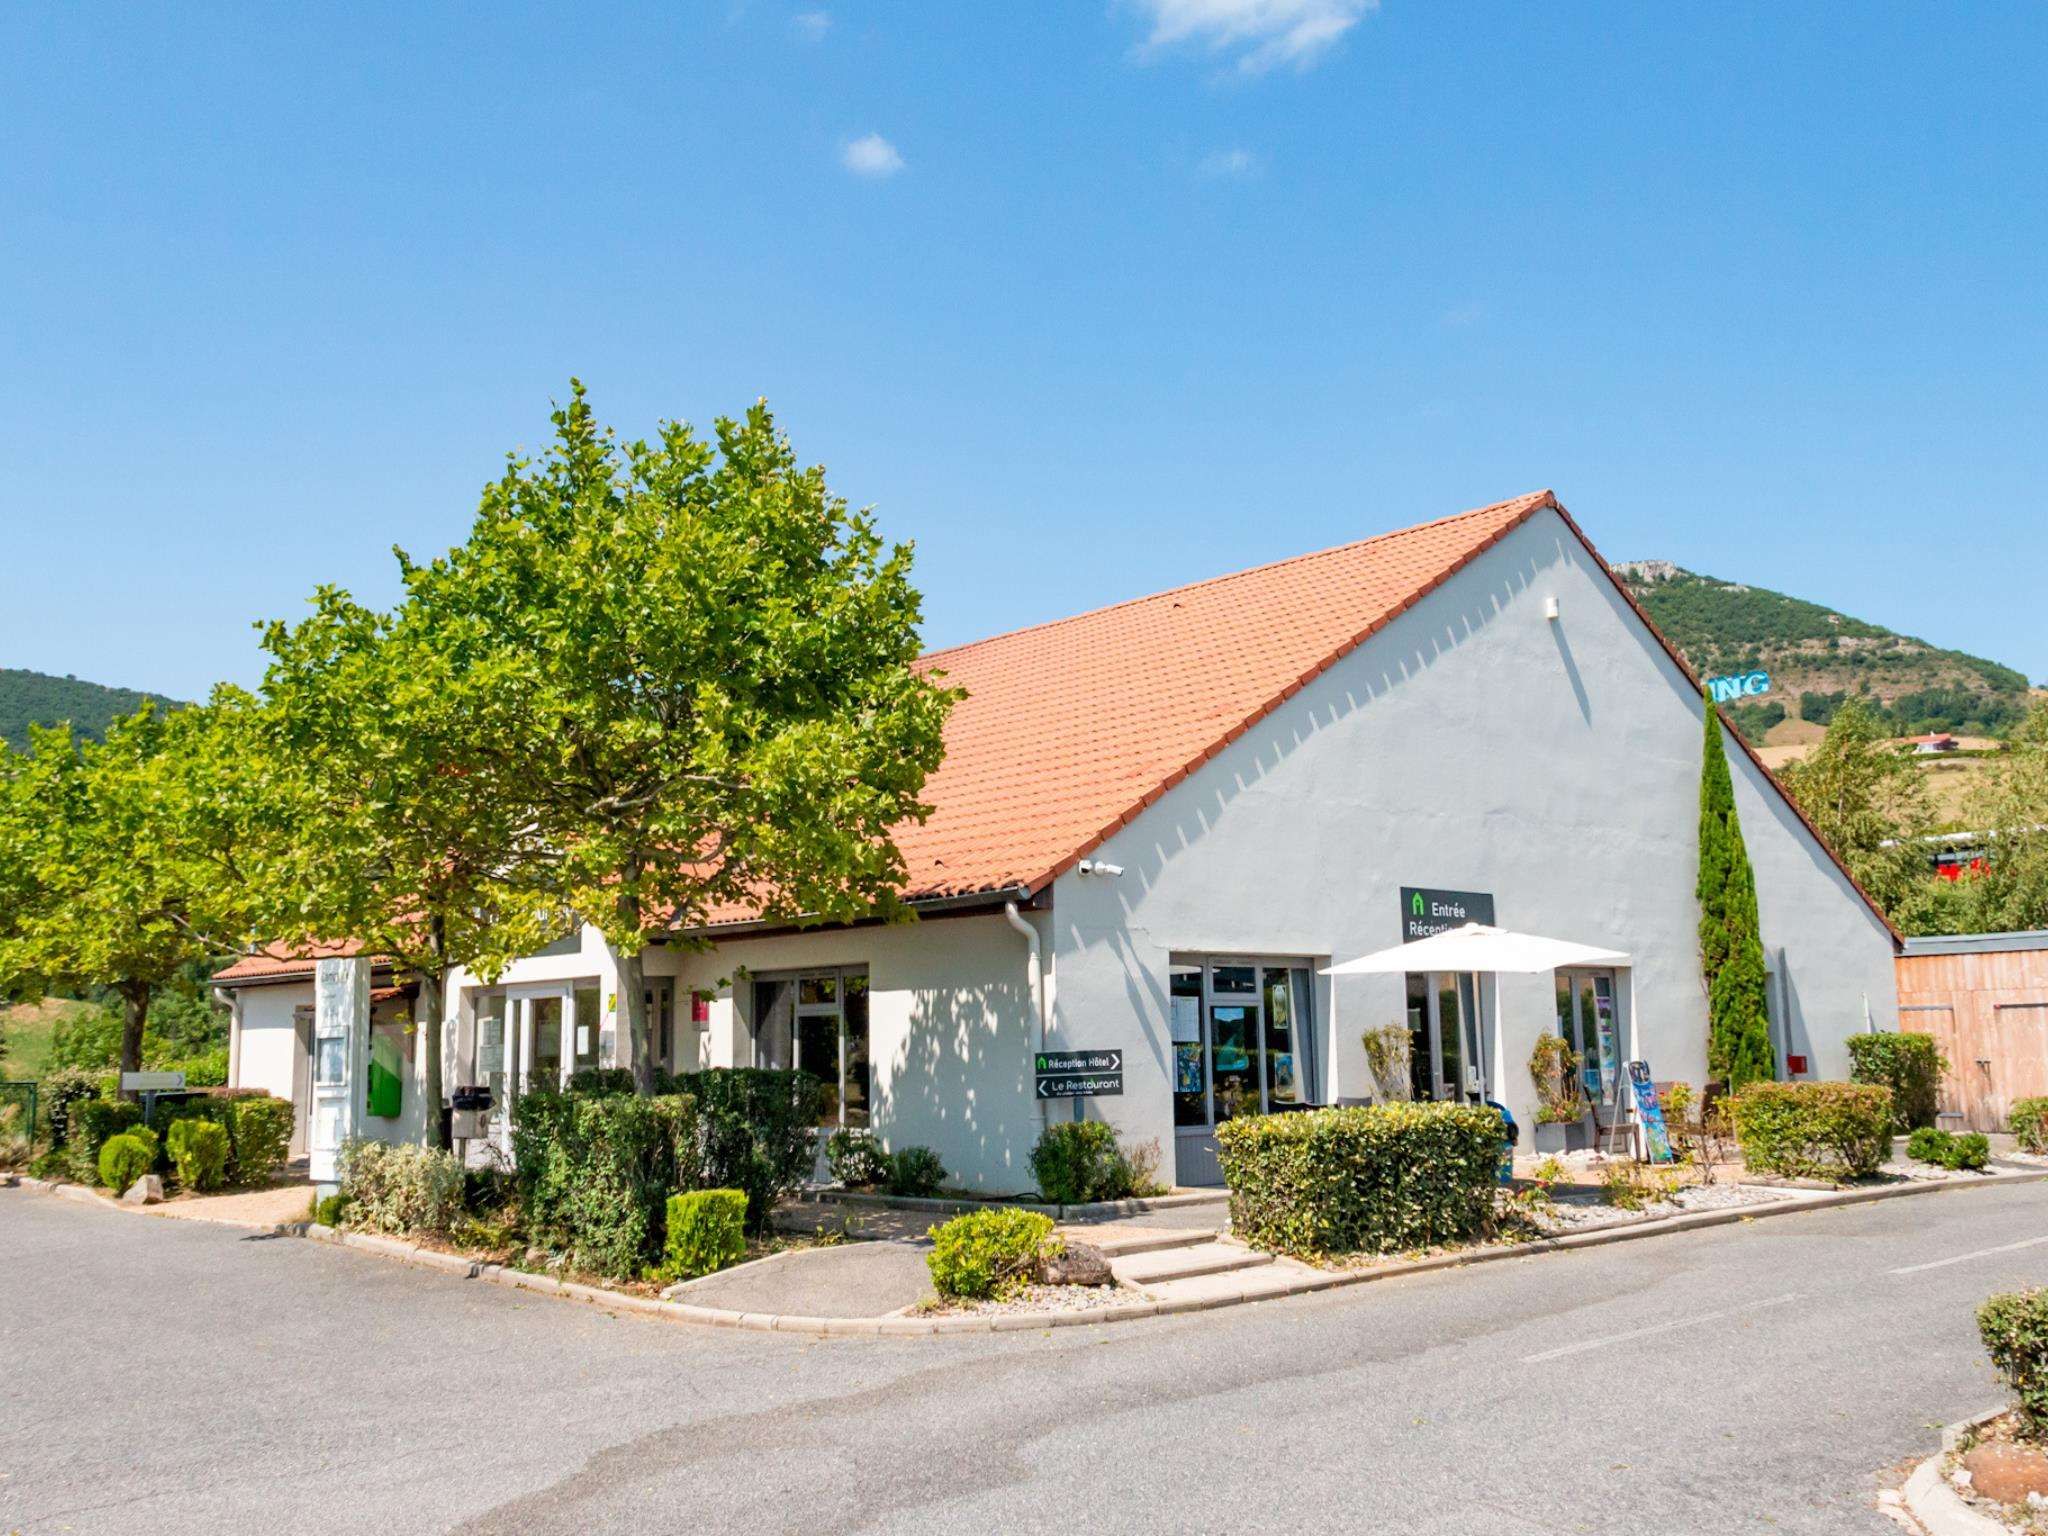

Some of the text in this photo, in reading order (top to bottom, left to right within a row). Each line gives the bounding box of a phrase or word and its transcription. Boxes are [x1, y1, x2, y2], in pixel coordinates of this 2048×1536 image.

[1432, 902, 1466, 918] Entrée
[1048, 1056, 1110, 1070] Réception Hôtel
[1051, 1079, 1120, 1091] Le Restaurant
